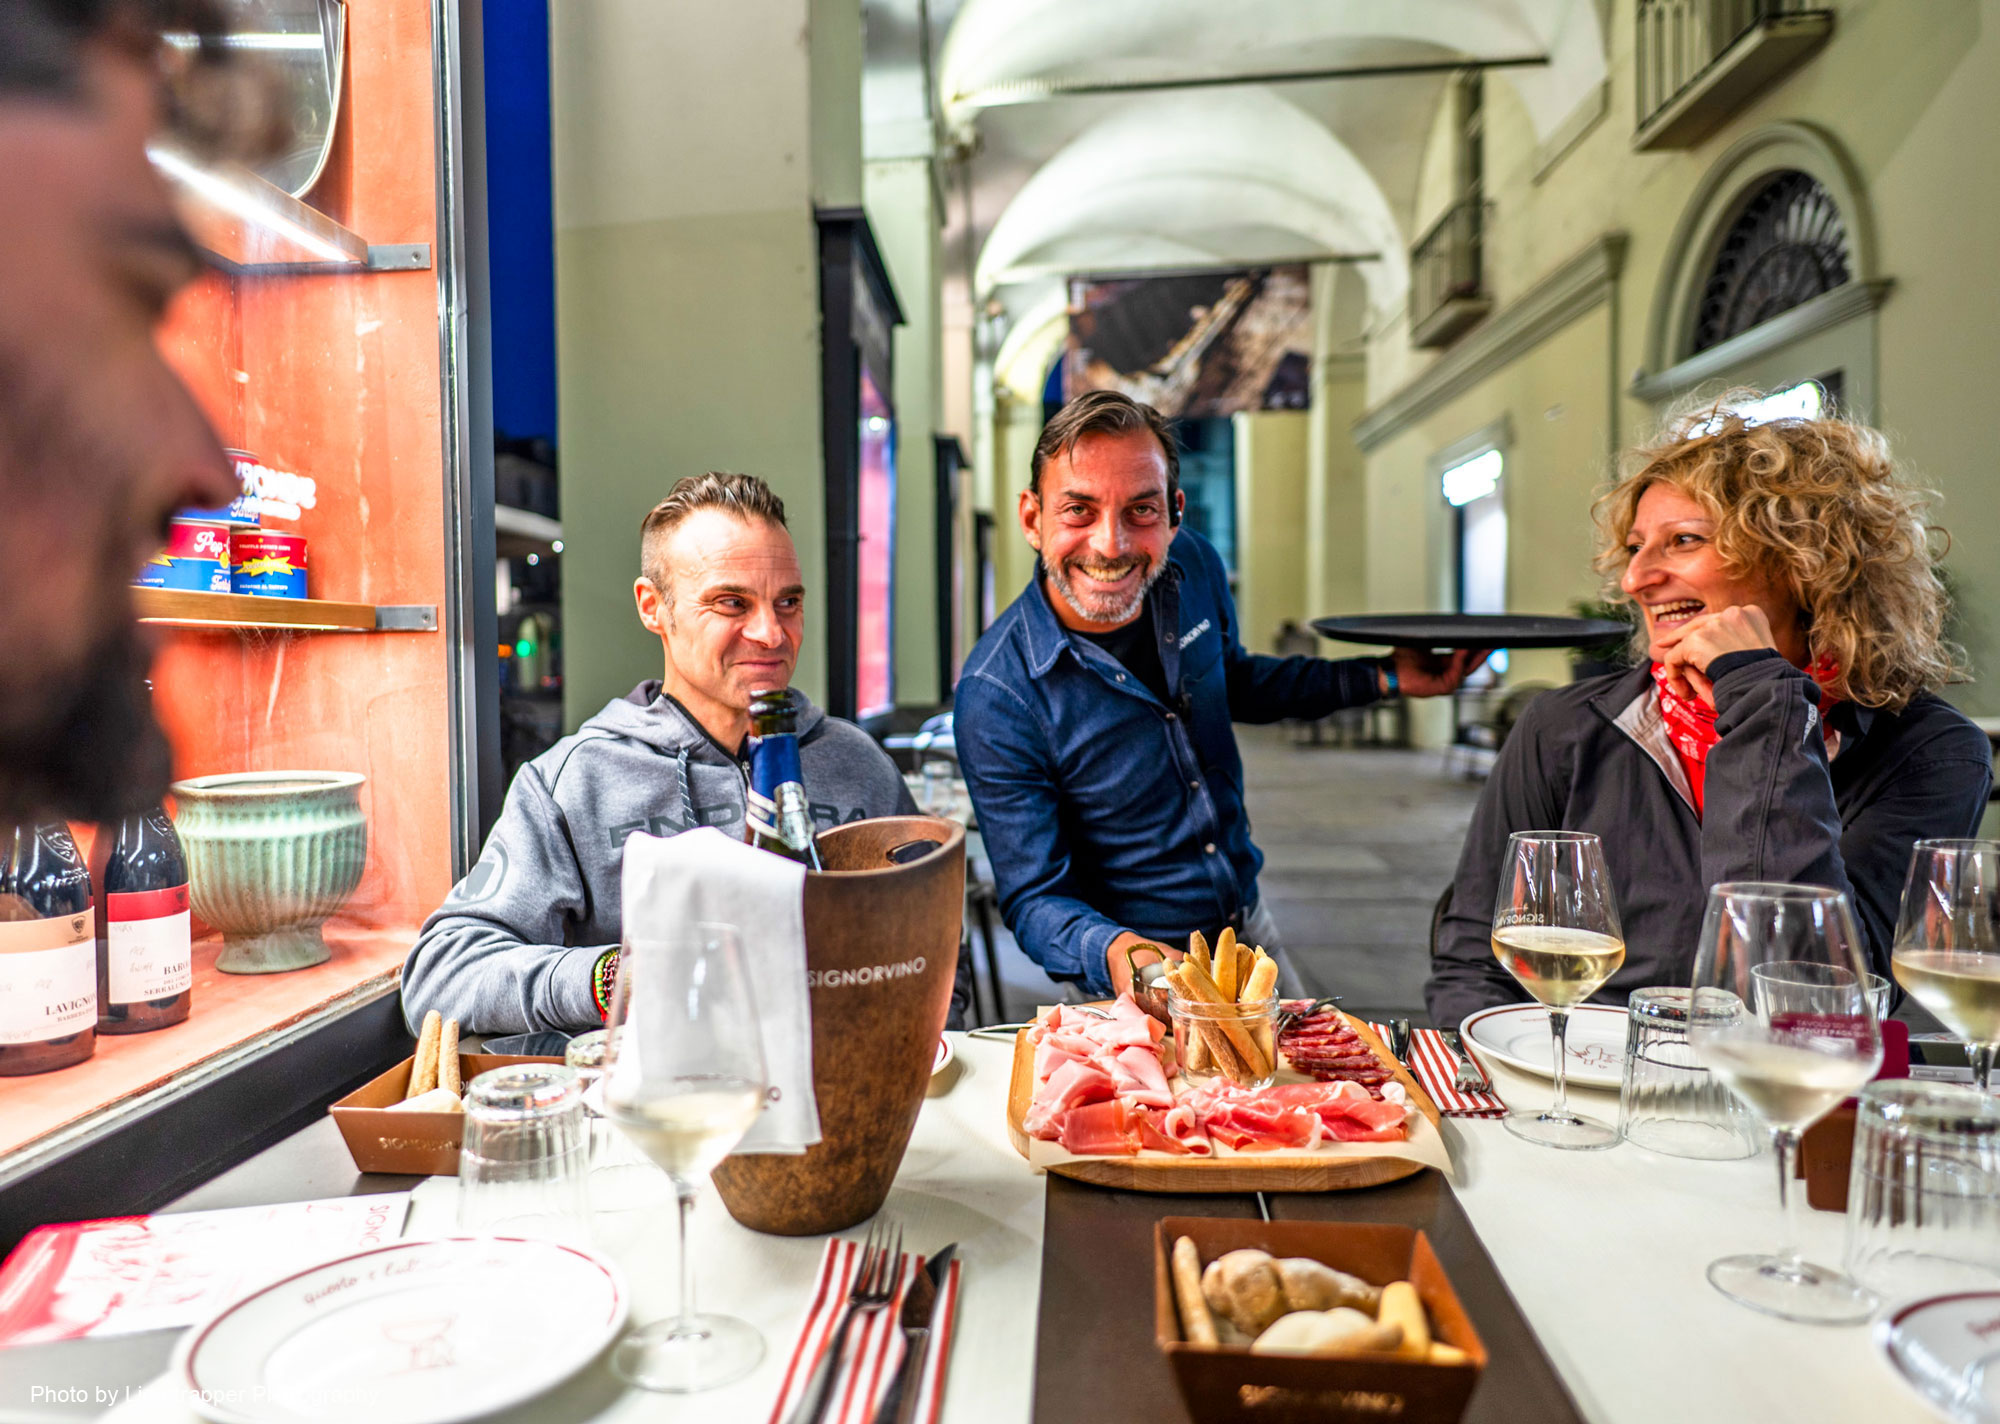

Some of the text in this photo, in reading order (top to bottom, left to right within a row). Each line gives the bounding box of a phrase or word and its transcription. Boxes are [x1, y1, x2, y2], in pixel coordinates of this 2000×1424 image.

[194, 531, 231, 556] Pop-
[609, 802, 868, 849] ENDRA
[807, 956, 926, 988] SIGNORVINO
